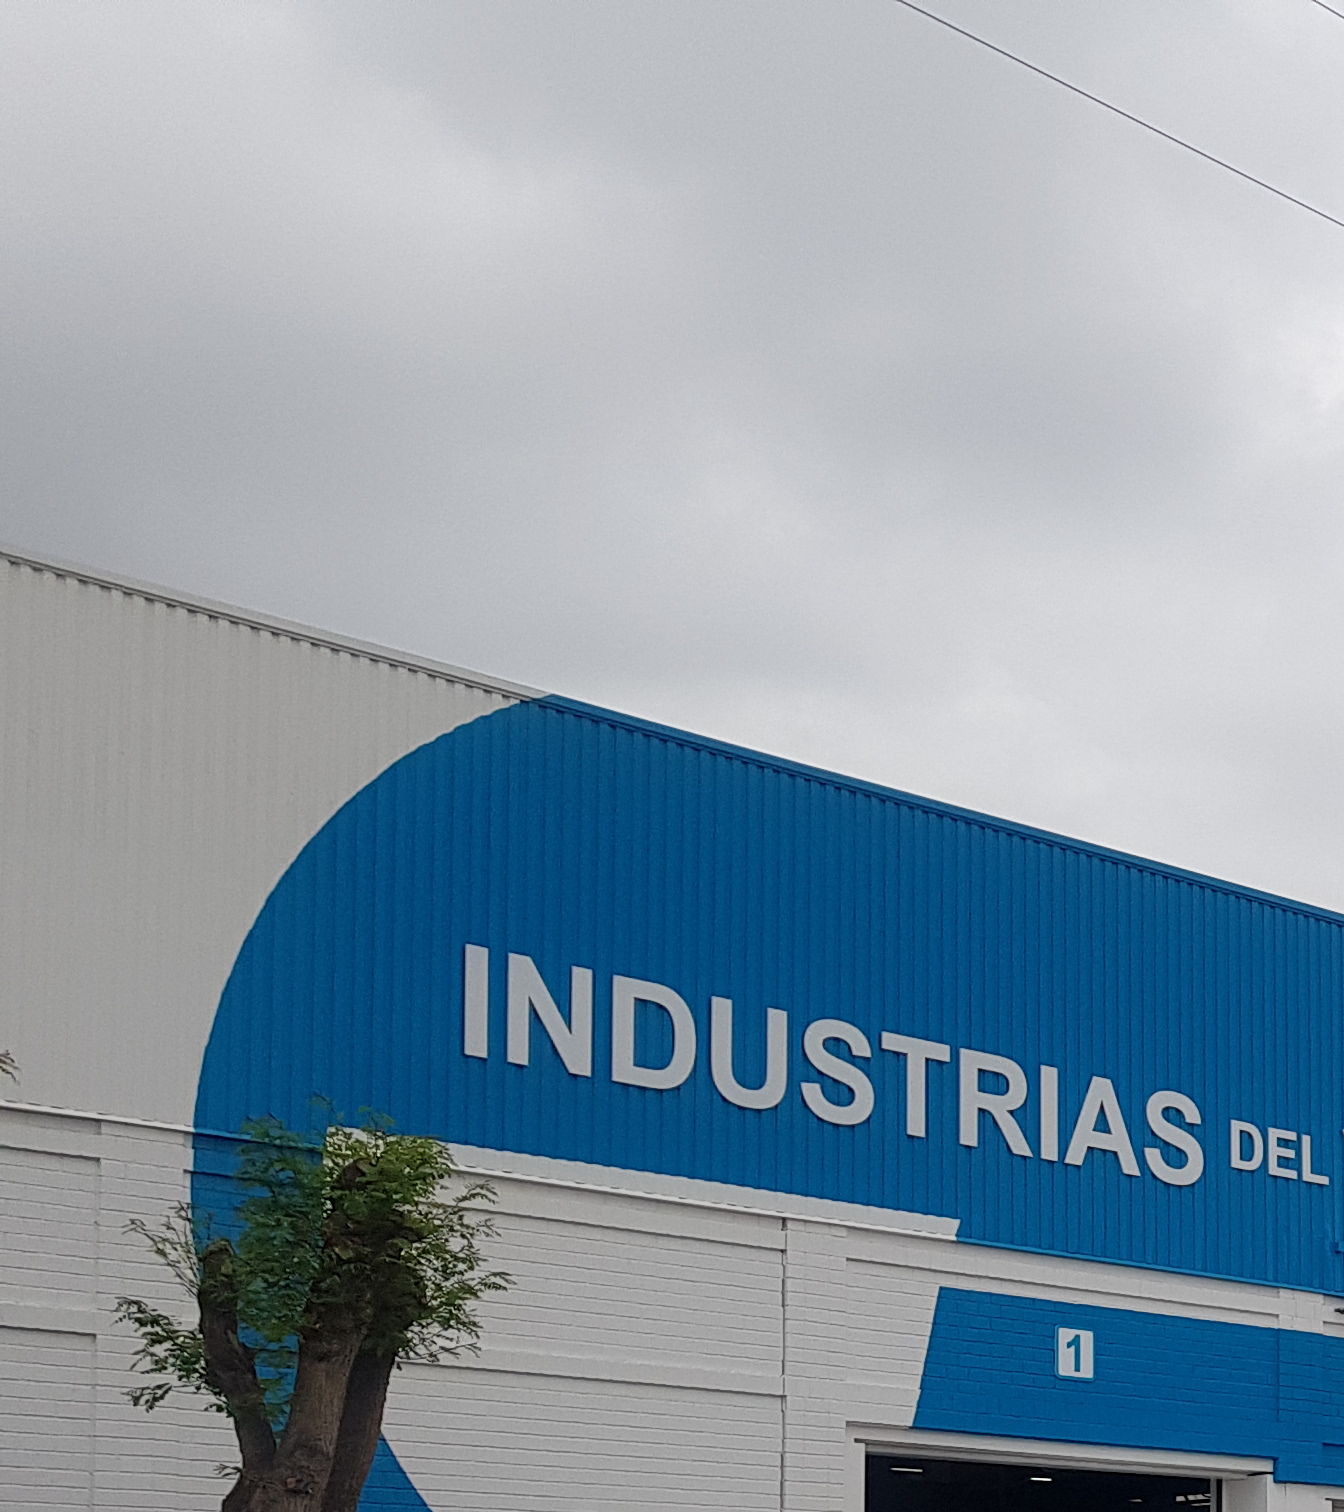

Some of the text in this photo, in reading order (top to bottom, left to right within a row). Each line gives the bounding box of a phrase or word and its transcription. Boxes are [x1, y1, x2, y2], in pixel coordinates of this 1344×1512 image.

[463, 943, 1204, 1186] INDUSTRIAS
[1229, 1119, 1330, 1186] DEL
[1066, 1334, 1084, 1375] 1
